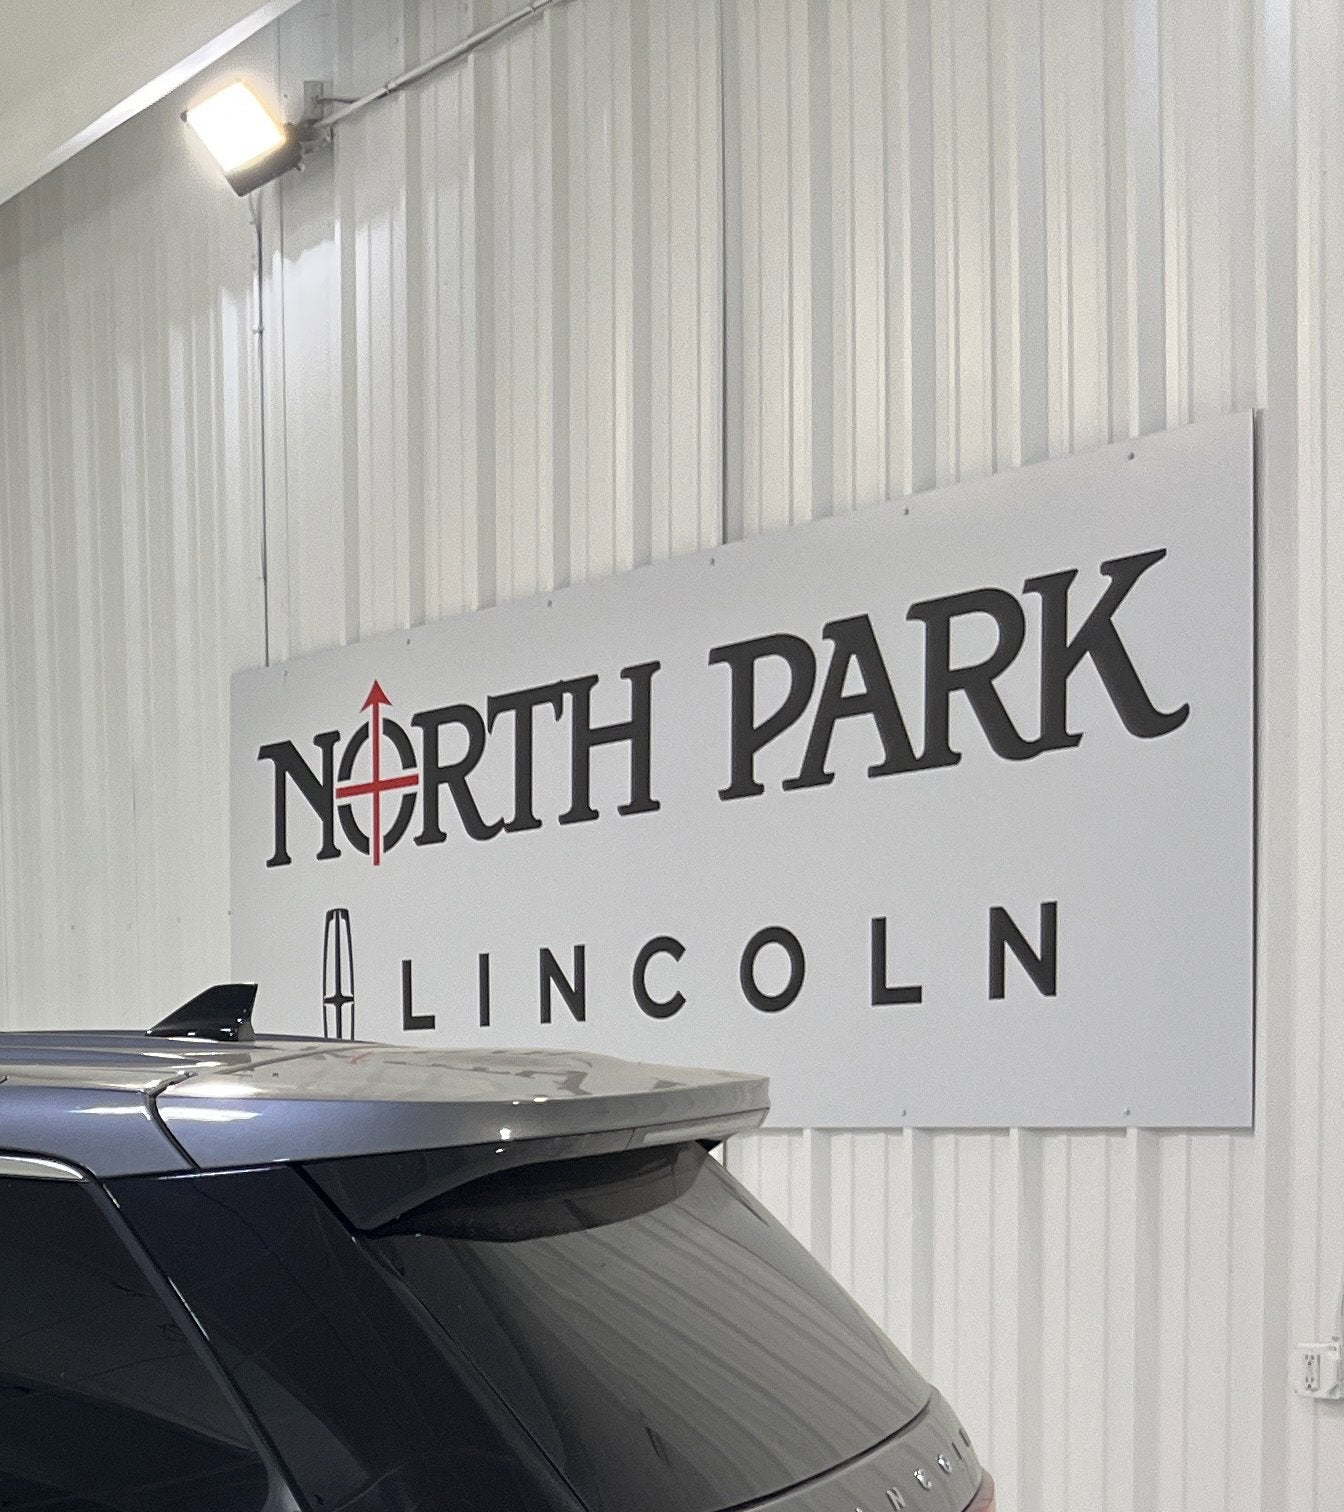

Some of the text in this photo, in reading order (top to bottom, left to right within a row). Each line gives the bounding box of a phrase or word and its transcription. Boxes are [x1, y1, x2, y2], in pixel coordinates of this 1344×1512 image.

[258, 548, 1191, 869] NORTH PARK
[401, 900, 1059, 1031] LINCOLN
